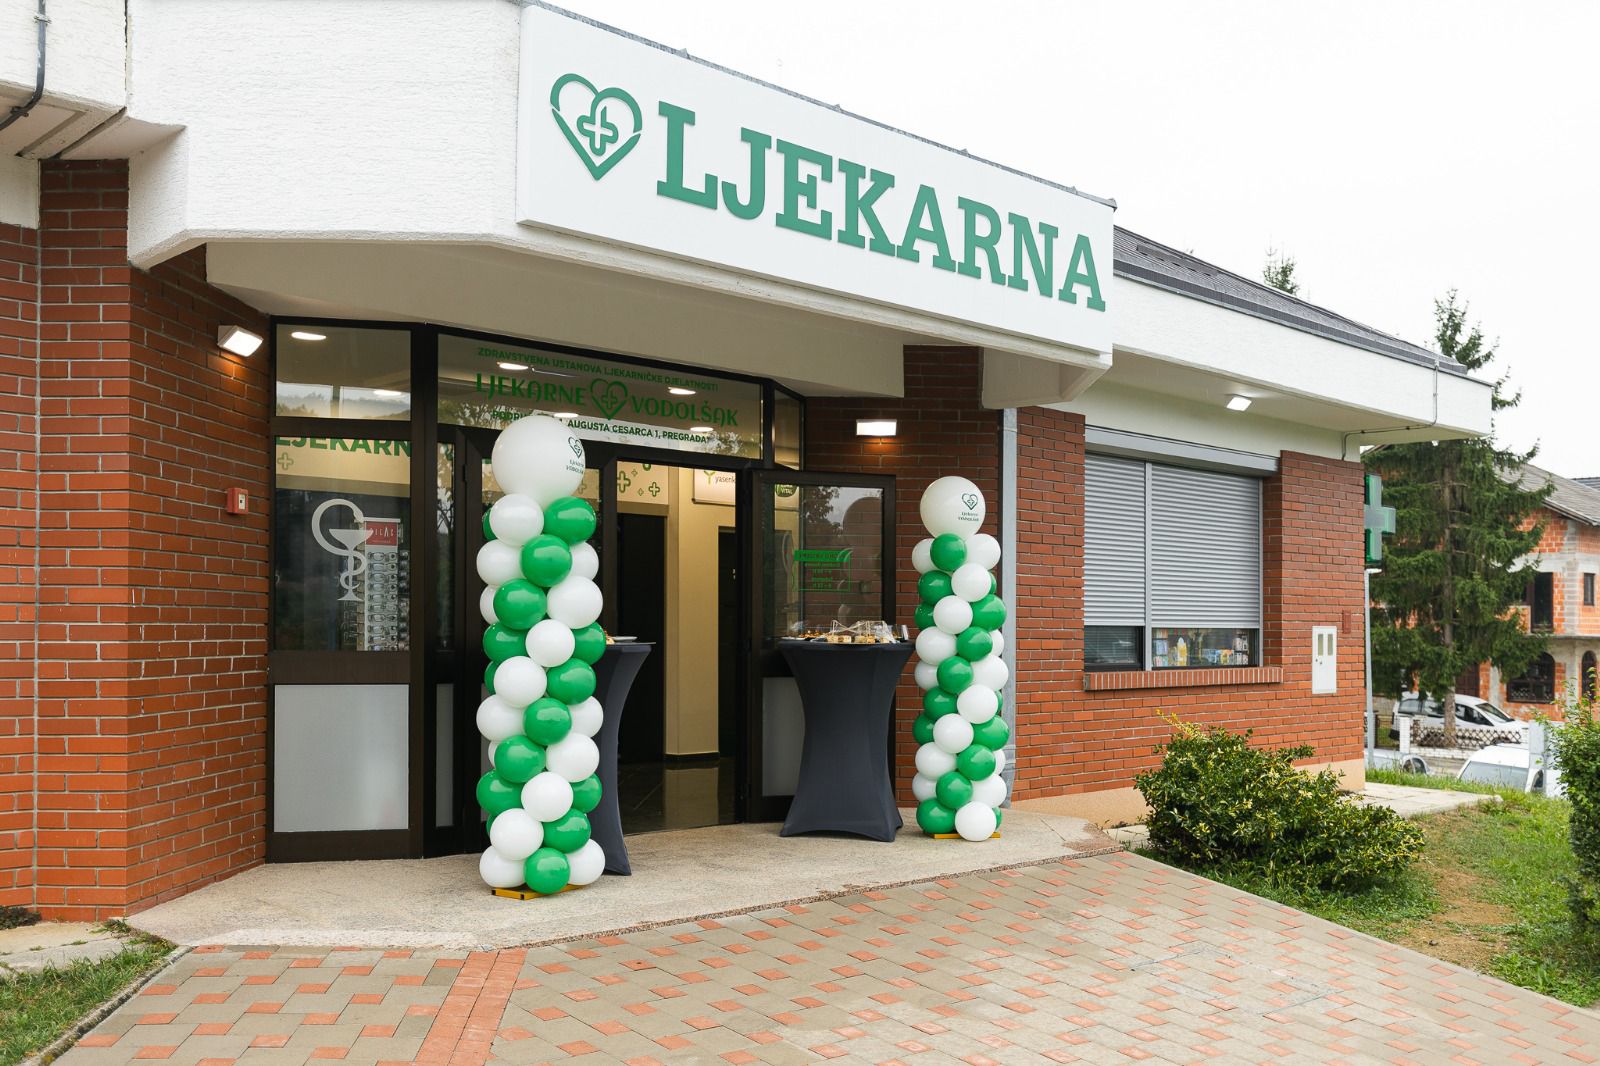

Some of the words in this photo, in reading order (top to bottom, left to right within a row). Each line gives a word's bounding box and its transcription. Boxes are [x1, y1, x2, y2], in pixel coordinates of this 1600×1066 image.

[656, 100, 1106, 312] LJEKARNA
[478, 347, 550, 366] ZDRAVSTVENA
[552, 360, 601, 374] USTANOVA
[604, 367, 663, 383] LJEKARNIČKE
[664, 376, 719, 392] DJELATNOSTI
[475, 372, 588, 407] LJEKARNE
[630, 394, 739, 428] VODOLŠAK
[567, 419, 610, 433] AUGUSTA
[611, 424, 655, 438] CESARCA
[662, 430, 708, 444] PREGRADA
